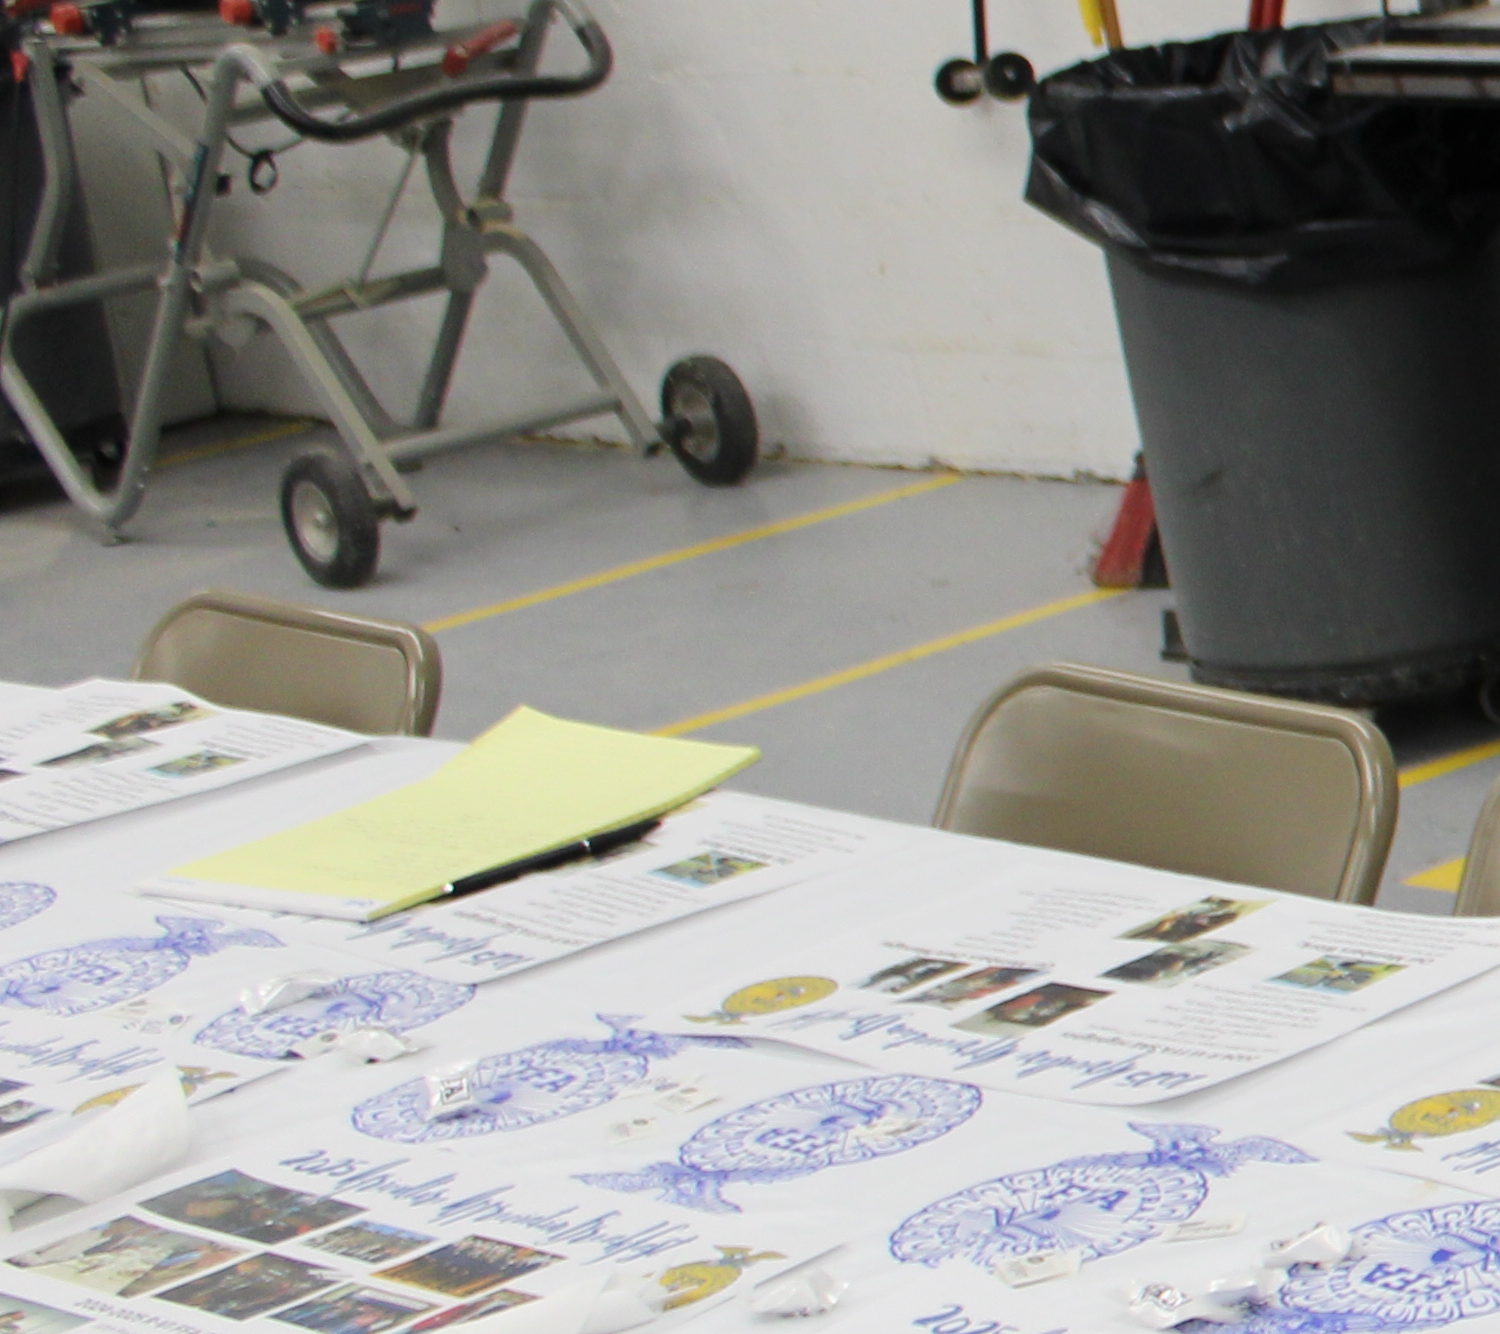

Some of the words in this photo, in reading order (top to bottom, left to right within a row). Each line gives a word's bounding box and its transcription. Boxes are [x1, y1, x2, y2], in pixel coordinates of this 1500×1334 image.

[278, 1150, 368, 1177] 2025
[1041, 1182, 1128, 1211] FFA
[1364, 1262, 1459, 1293] FFA
